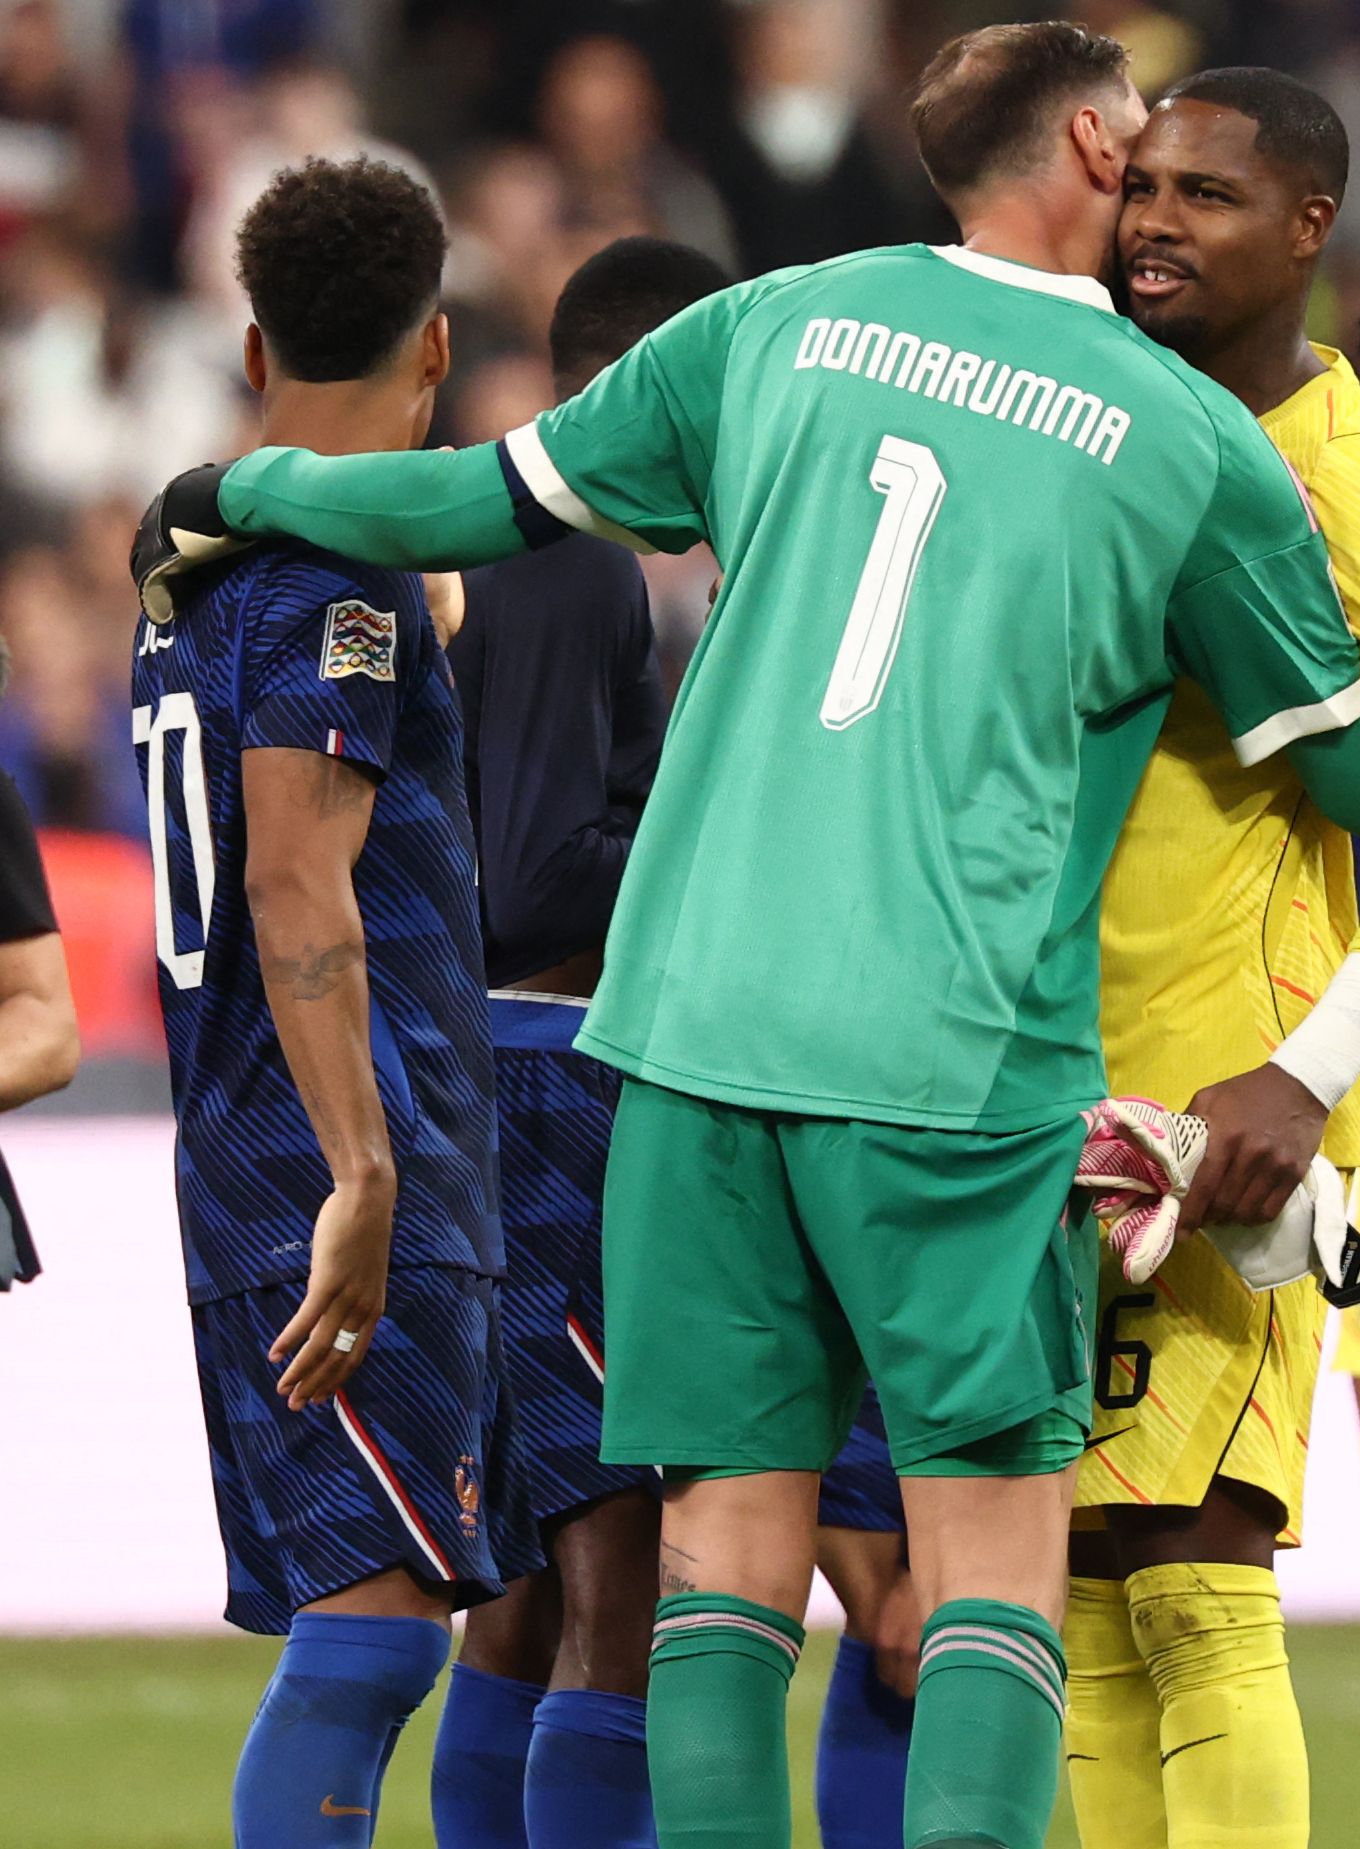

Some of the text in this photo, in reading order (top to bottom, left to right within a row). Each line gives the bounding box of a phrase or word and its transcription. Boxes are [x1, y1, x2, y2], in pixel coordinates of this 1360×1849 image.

[794, 317, 1132, 466] DONNARUMMA
[818, 433, 948, 731] 1
[1094, 1293, 1156, 1410] 6
